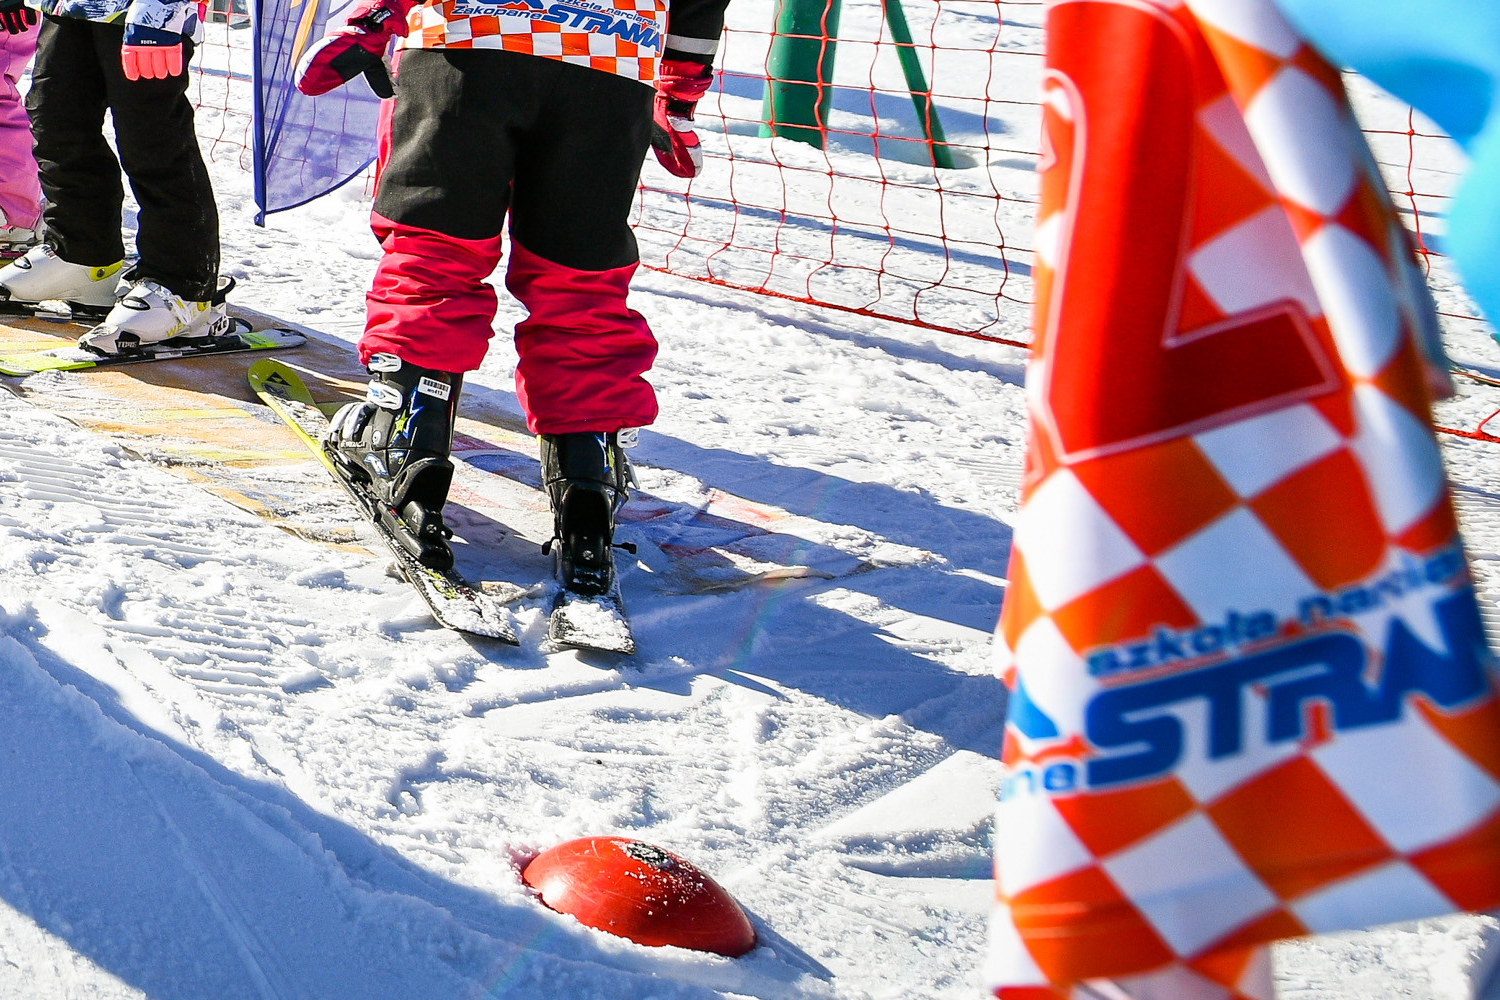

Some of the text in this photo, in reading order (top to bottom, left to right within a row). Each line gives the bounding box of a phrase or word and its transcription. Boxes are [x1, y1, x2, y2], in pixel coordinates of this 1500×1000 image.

[451, 4, 542, 20] Zakopane
[606, 6, 661, 30] narciarska
[541, 3, 661, 54] STRAMA
